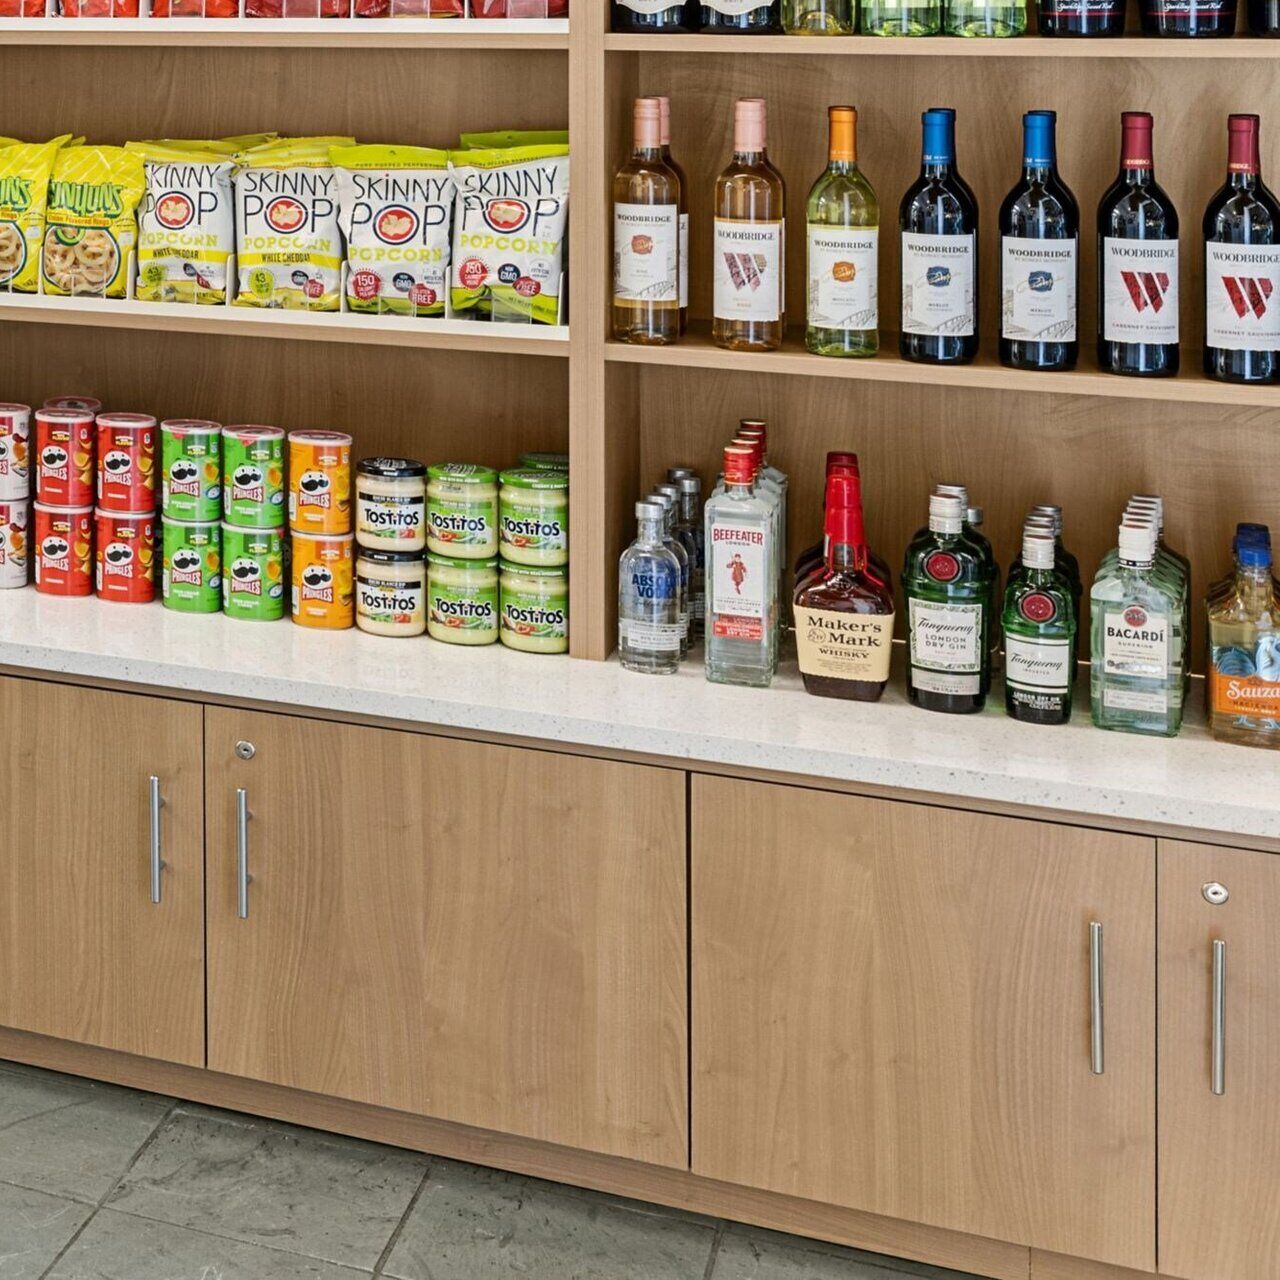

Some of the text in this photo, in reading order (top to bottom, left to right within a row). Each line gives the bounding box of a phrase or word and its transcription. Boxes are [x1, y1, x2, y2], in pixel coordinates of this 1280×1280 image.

[145, 164, 221, 190] SKINNY
[244, 170, 335, 199] SKINNY
[464, 165, 558, 197] SKINNY
[352, 173, 448, 202] SKINNY
[142, 190, 219, 231] POP
[244, 195, 334, 235] POP
[462, 194, 560, 237] POP
[617, 213, 672, 223] WOODBRIDGE
[349, 202, 446, 246] POP
[718, 229, 776, 241] WOODBRIDGE
[814, 239, 874, 249] WOODBRIDGE
[908, 243, 970, 254] WOODBRIDGE
[1111, 246, 1176, 258] WOODBRIDGE
[261, 252, 311, 263] WHITE CHEDDAR
[1008, 248, 1072, 258] WOODBRIDGE
[1213, 251, 1280, 264] WOODBRIDGE
[356, 274, 374, 286] 150
[413, 293, 433, 305] FREE
[170, 480, 200, 497] PRINGLES
[233, 486, 264, 502] PRINGLES
[300, 491, 330, 508] PRINGLES
[713, 528, 763, 546] BEEFEATER
[172, 569, 202, 586] PRINGLES
[232, 578, 262, 595] PRINGLES
[302, 585, 333, 603] PRINGLES
[807, 615, 882, 633] Maker's
[917, 617, 974, 635] Tanqueray
[828, 632, 882, 647] Mark
[925, 633, 966, 643] LONDON
[1107, 626, 1165, 642] BACARDÍ
[819, 647, 870, 659] WHISKY
[948, 642, 966, 650] GIN
[1011, 652, 1063, 670] Tanqueray
[1226, 680, 1280, 700] Sauza
